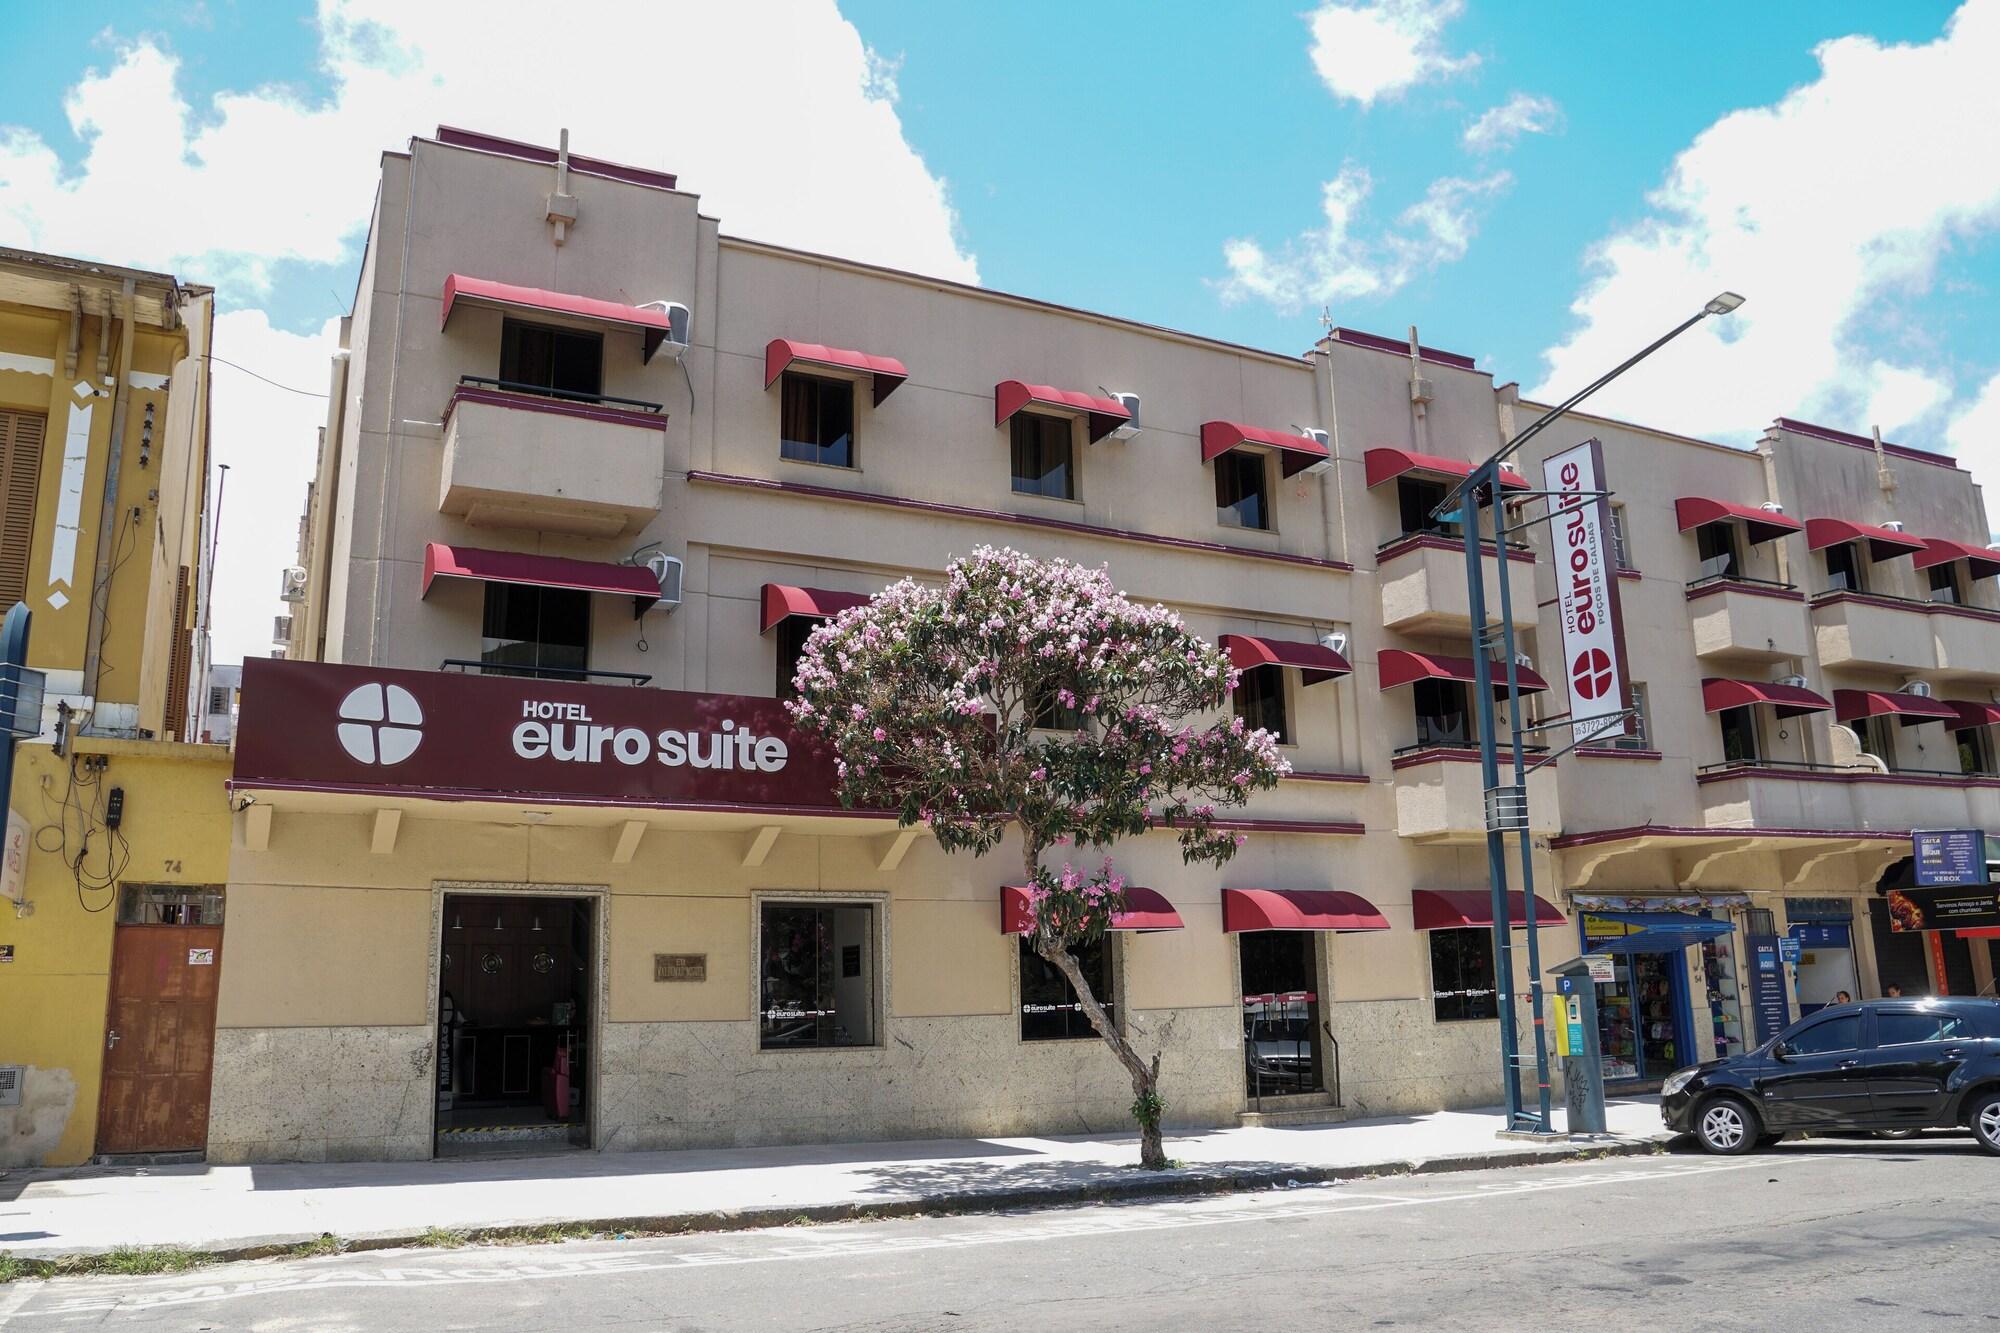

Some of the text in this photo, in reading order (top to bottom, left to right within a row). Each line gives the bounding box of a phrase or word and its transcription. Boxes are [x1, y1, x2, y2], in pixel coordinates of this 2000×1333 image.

[1587, 521, 1605, 625] POÇOS DE CALDAS
[1564, 591, 1576, 634] HOTEL
[522, 700, 593, 722] HOTEL
[1757, 945, 1773, 953] CAIXA
[1760, 960, 1775, 969] AQUI
[1563, 979, 1571, 992] P
[46, 1257, 651, 1310] EMBARQUE
[676, 1251, 739, 1263] E
